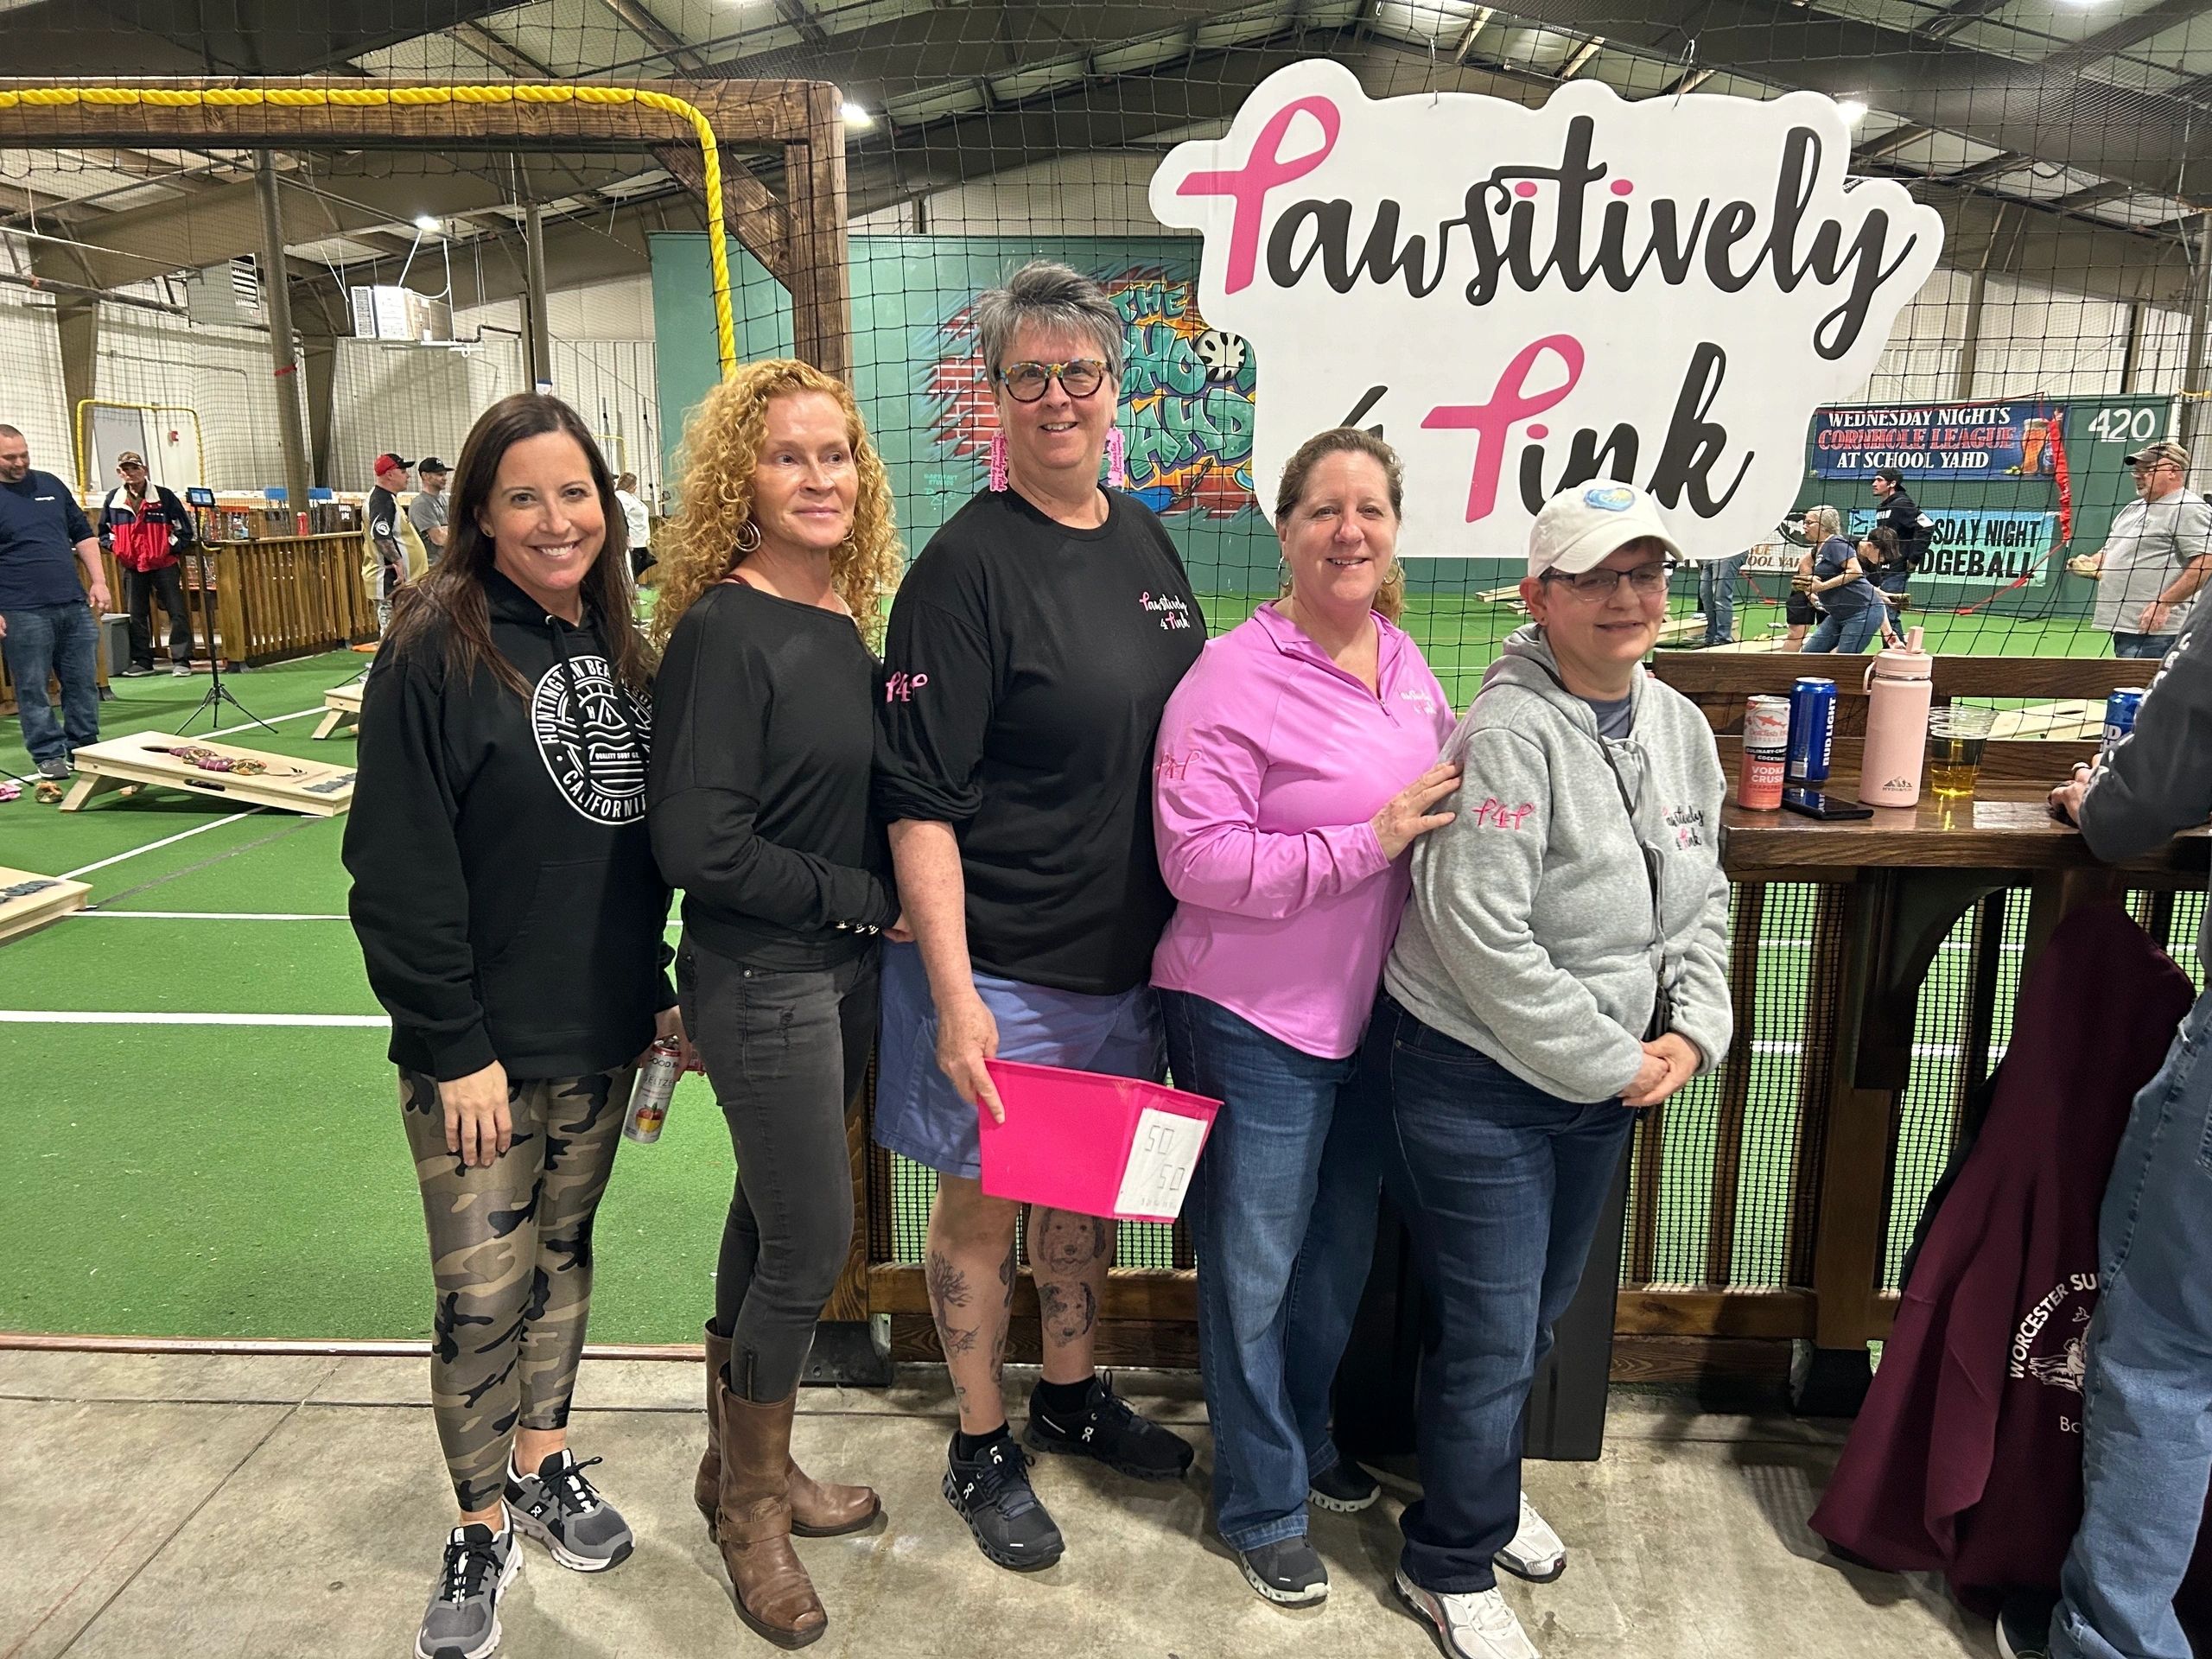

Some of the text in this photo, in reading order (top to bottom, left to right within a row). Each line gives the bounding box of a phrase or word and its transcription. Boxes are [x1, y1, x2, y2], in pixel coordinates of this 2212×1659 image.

[1176, 95, 1917, 360] Pawsitively
[1109, 284, 1186, 322] THE
[1421, 334, 1755, 522] Pink
[1829, 407, 2011, 427] WEDNESDAY NIGHTS
[2088, 408, 2156, 442] 420
[1818, 427, 2017, 450] CORNHOLE LEAGUE
[1837, 452, 1989, 468] AT SCHOOL YAHD
[1930, 518, 2040, 548] SDAY NIGHT
[1916, 550, 2035, 578] DGEBALL
[1160, 611, 1191, 630] 4 Pink
[536, 659, 586, 744] HUNTINGTN
[1822, 696, 1837, 766] BUD LIGHT
[1471, 796, 1535, 830] P4P
[1145, 1125, 1174, 1154] 50
[1157, 1164, 1185, 1191] 50
[2010, 1273, 2098, 1380] WORCESTER SU
